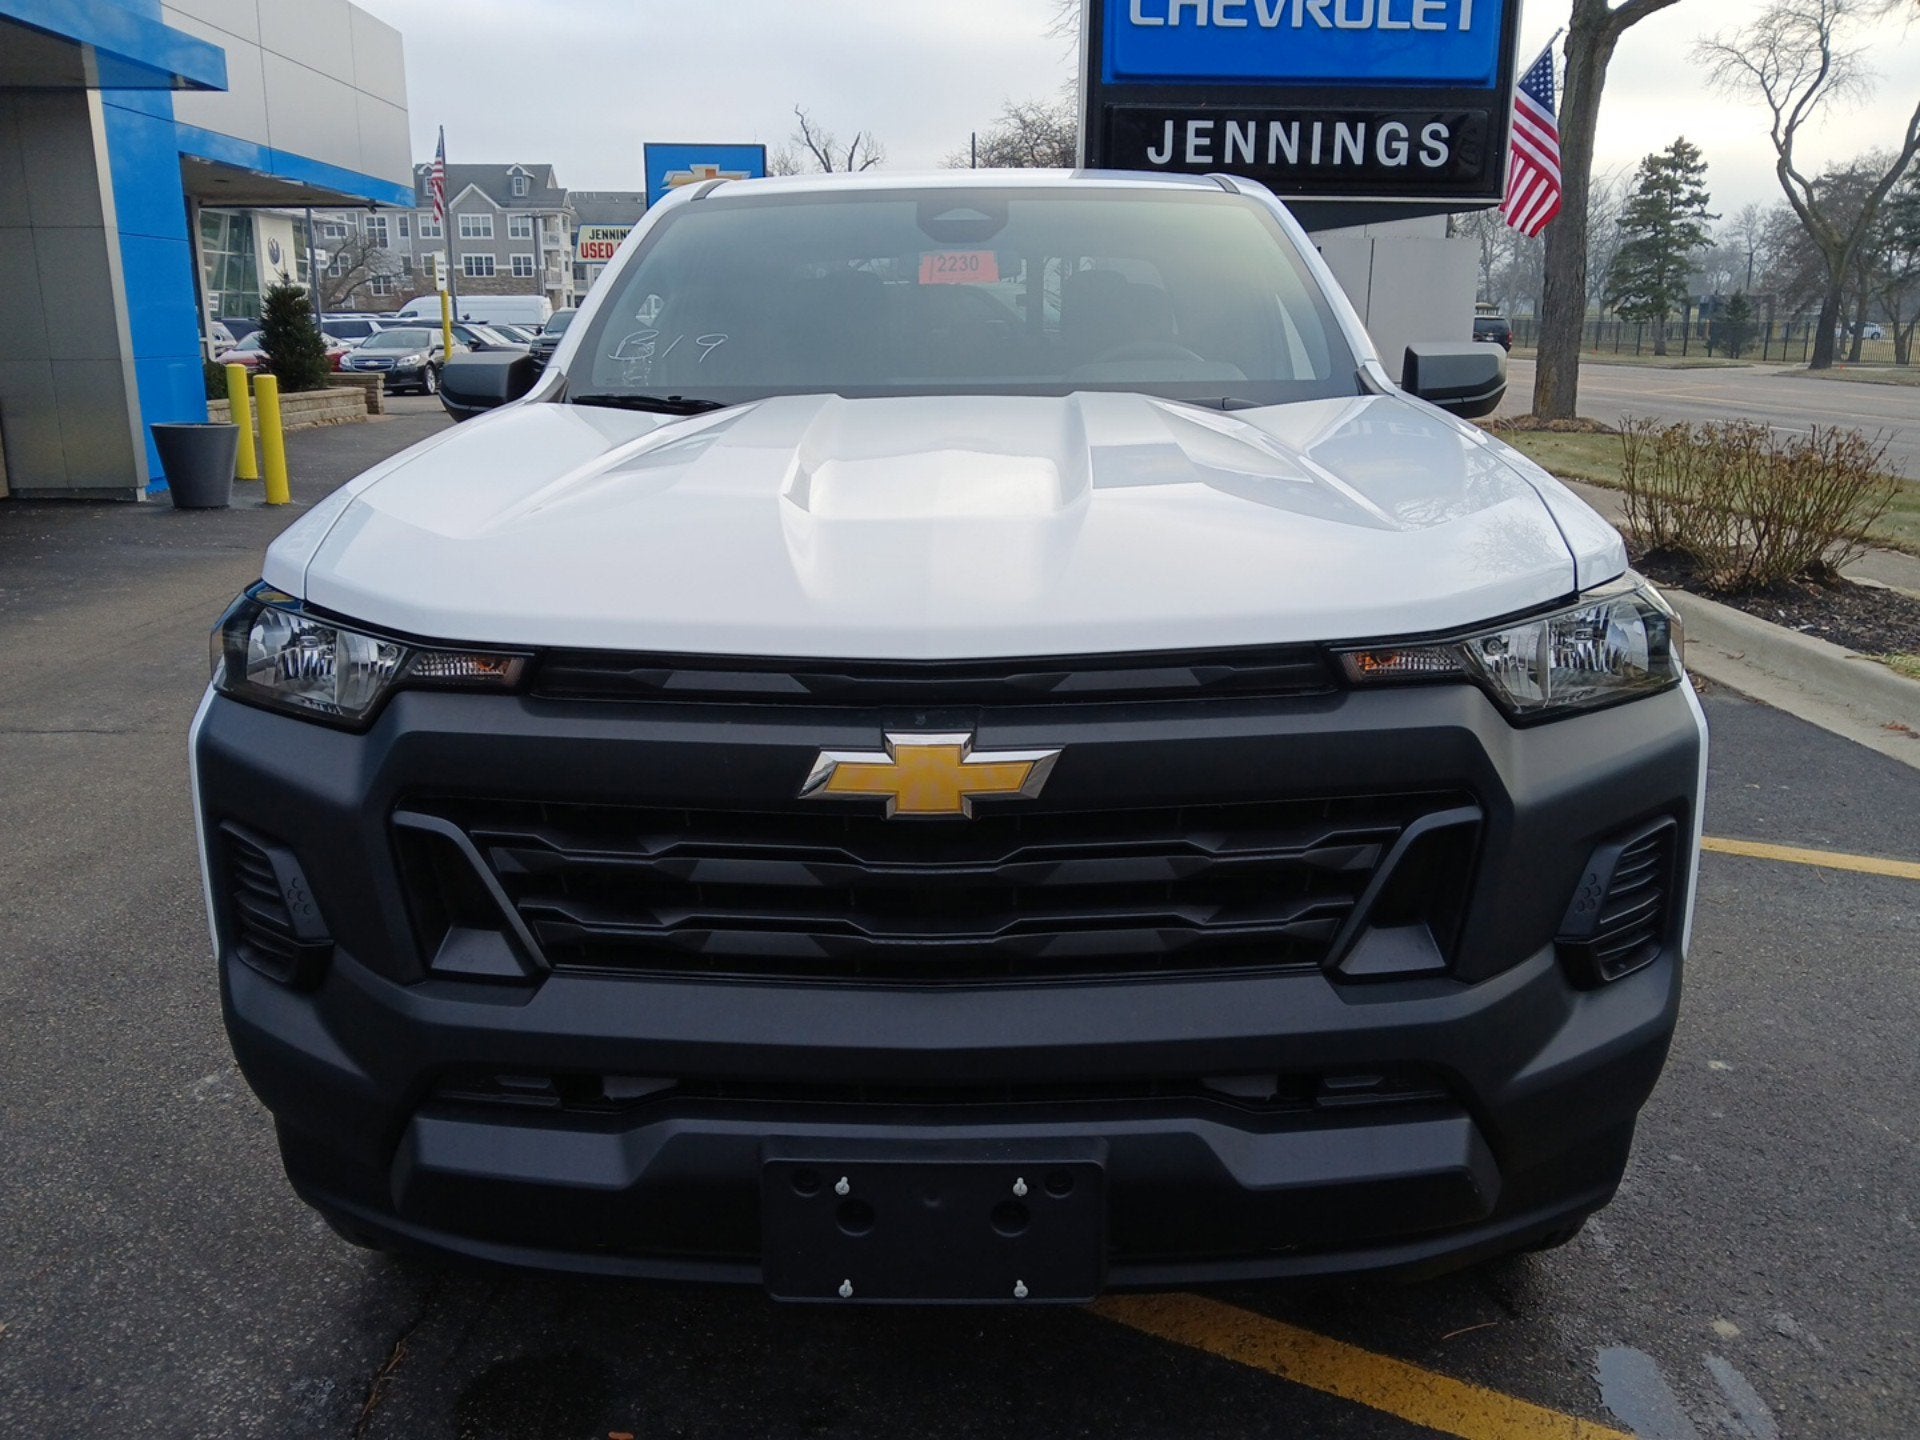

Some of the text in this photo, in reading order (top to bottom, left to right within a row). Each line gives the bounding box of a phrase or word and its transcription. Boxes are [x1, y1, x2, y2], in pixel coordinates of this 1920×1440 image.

[1129, 0, 1473, 30] CHEVROLET
[1147, 119, 1450, 168] JENNINGS
[589, 229, 632, 240] JENNIN
[580, 242, 614, 259] USED
[937, 255, 980, 272] 2230
